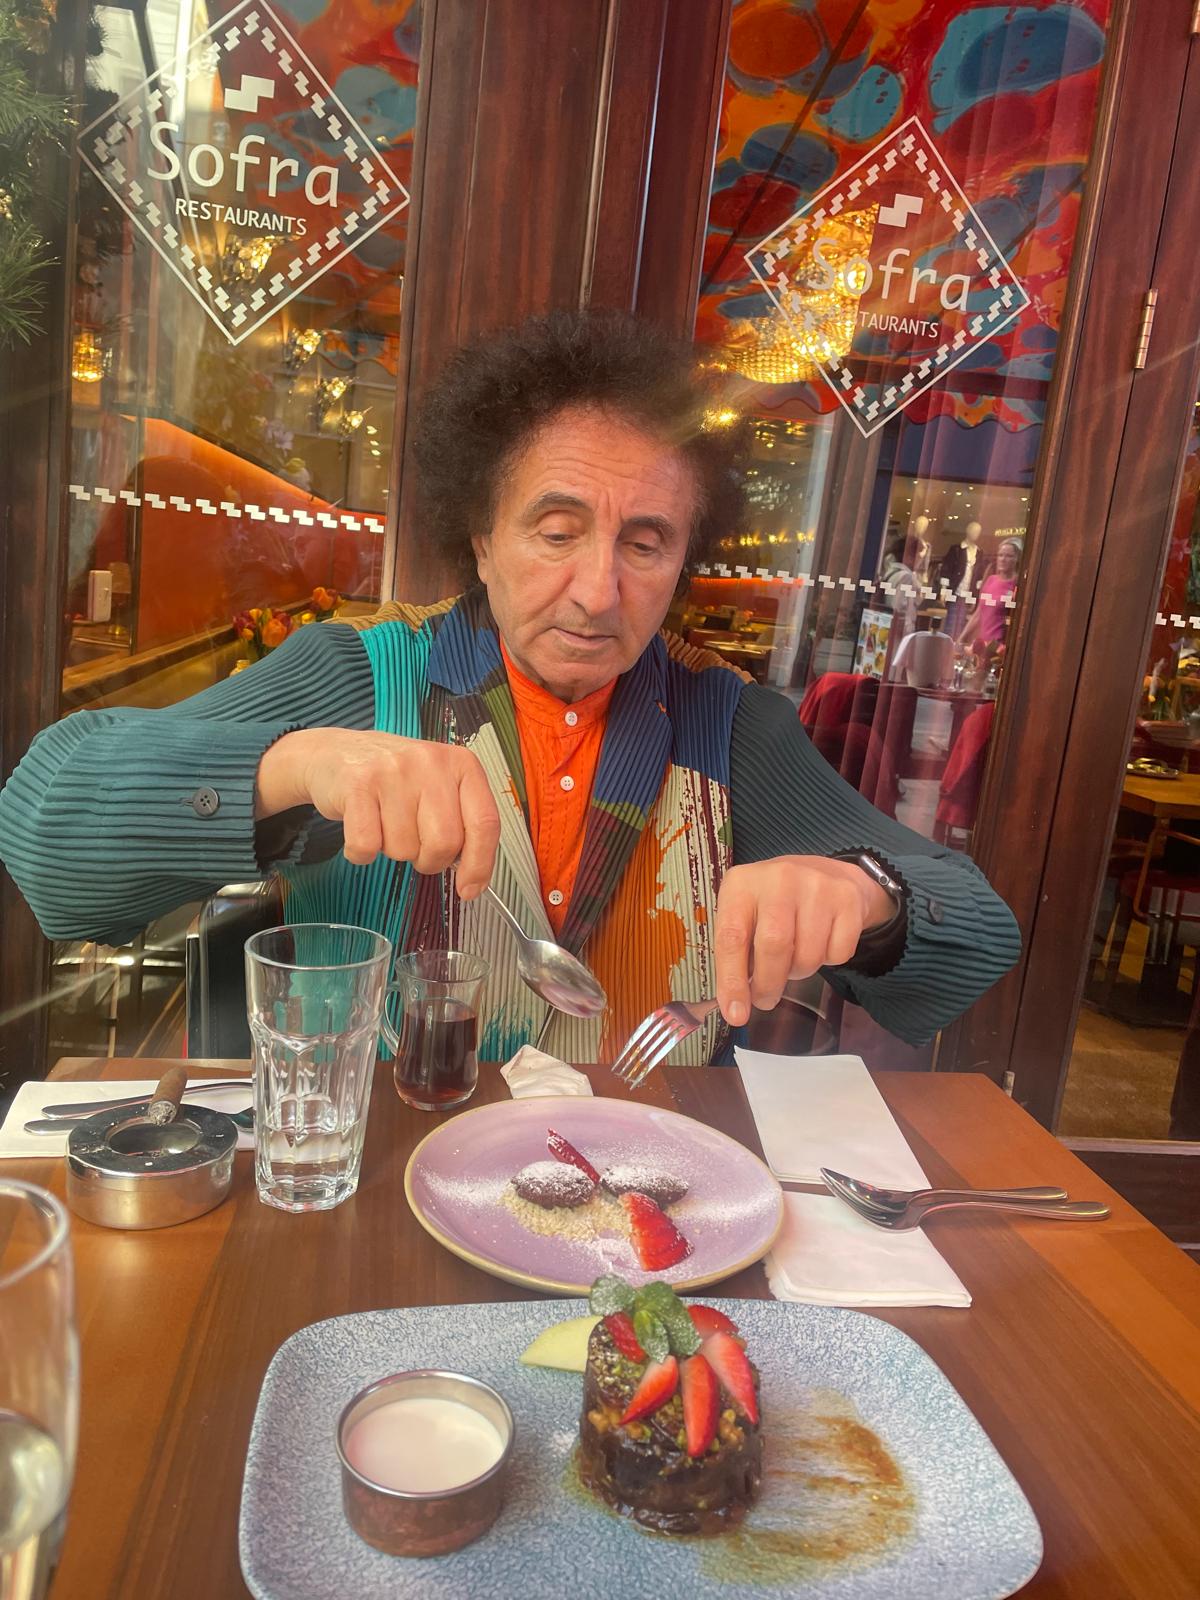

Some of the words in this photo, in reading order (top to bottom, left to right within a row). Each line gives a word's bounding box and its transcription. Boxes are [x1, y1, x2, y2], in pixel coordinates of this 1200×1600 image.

[146, 120, 340, 208] Sofra
[174, 197, 308, 237] RESTAURANTS
[807, 237, 972, 312] Sofra
[855, 309, 940, 339] TAURANTS
